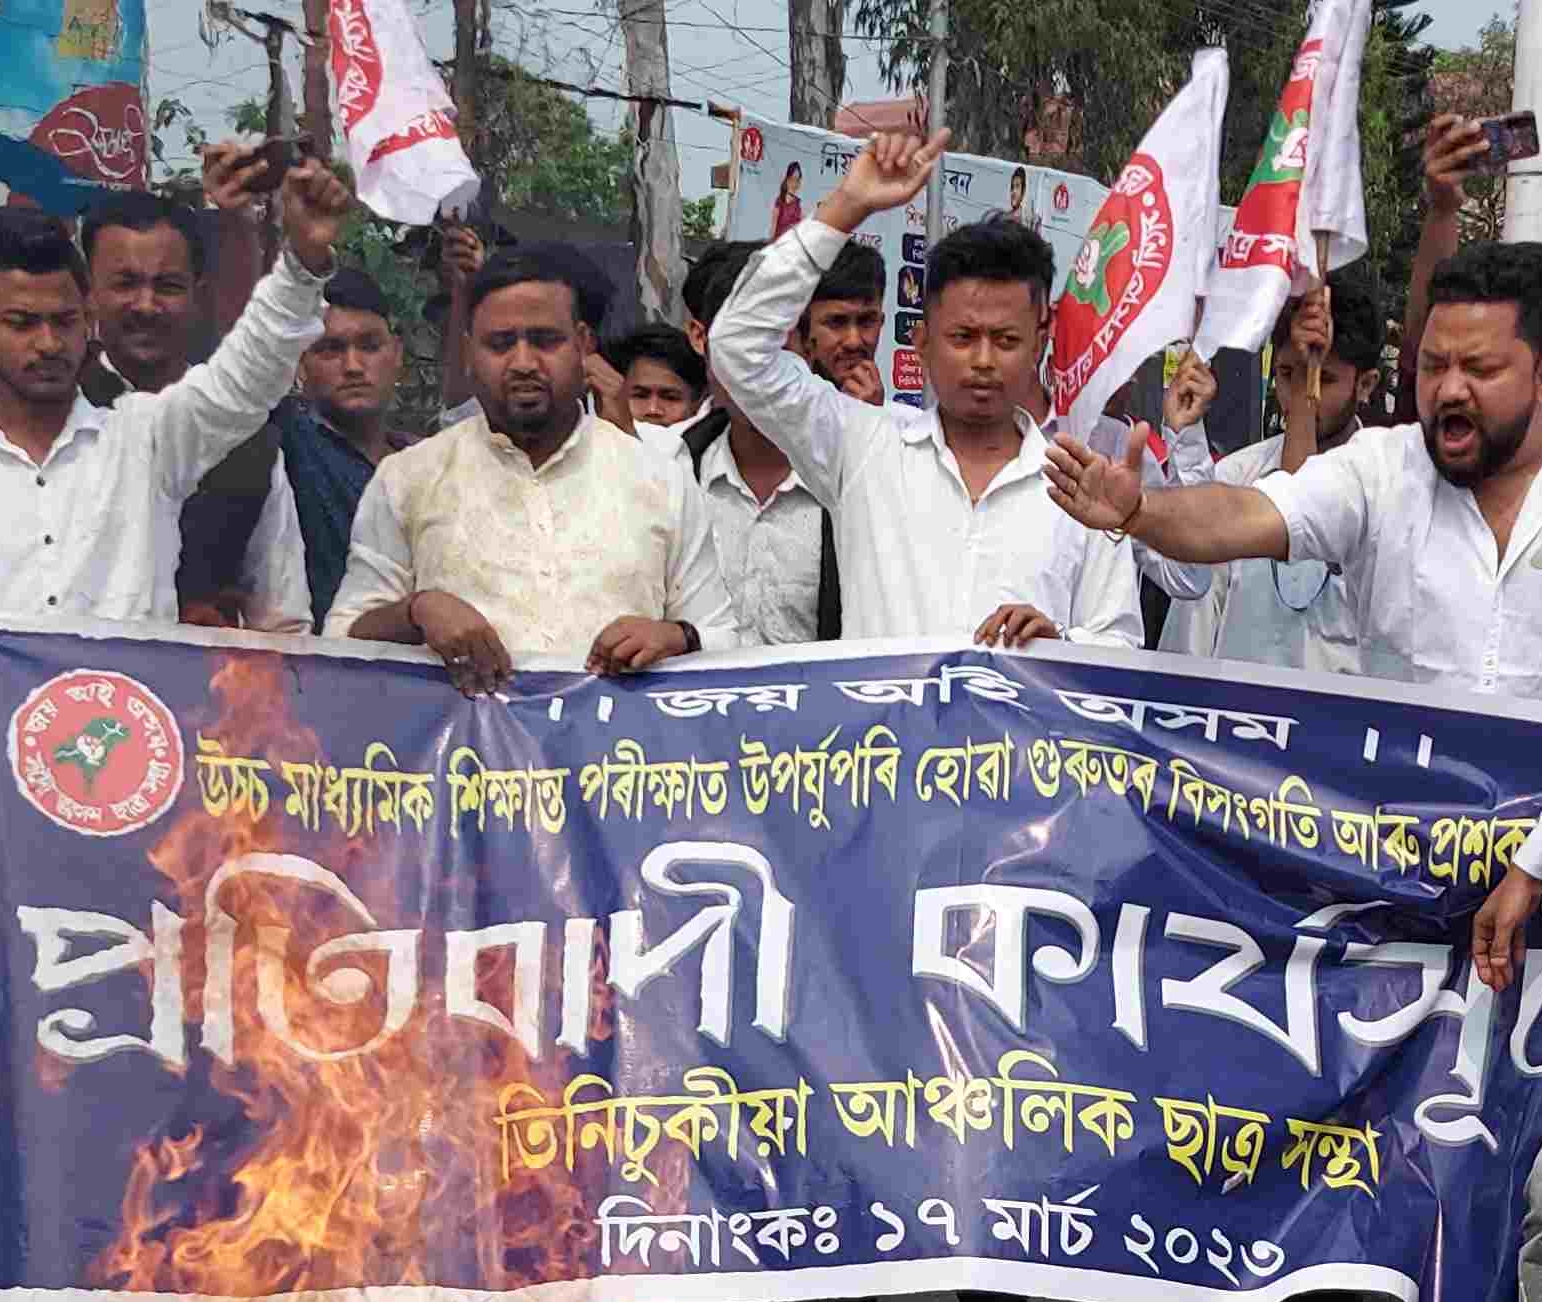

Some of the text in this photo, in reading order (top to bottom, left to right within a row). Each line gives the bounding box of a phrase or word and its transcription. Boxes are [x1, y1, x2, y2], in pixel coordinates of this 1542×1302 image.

[24, 698, 59, 734] জয়
[65, 678, 116, 709] আই
[645, 682, 811, 718] জয়
[832, 665, 1030, 711] আই
[1054, 690, 1299, 749] অসম
[196, 730, 271, 823] উচ্চ
[282, 741, 435, 838] মাধ্যমিক
[446, 746, 571, 839] শিক্ষান্ত
[579, 738, 730, 822] পৰীক্ষাত
[916, 730, 1018, 806] হোৱা
[1024, 737, 1159, 814] গুৰুতৰ
[1165, 755, 1322, 851] বিসংগতি
[1329, 805, 1421, 876] আৰু
[494, 1066, 815, 1187] তিনিচুকীয়া
[827, 1048, 1138, 1157] আঞ্চলিক
[1152, 1092, 1272, 1195] ছাত্ৰ
[869, 1197, 961, 1253] ১৭
[1123, 1212, 1286, 1288] ২০২৩
